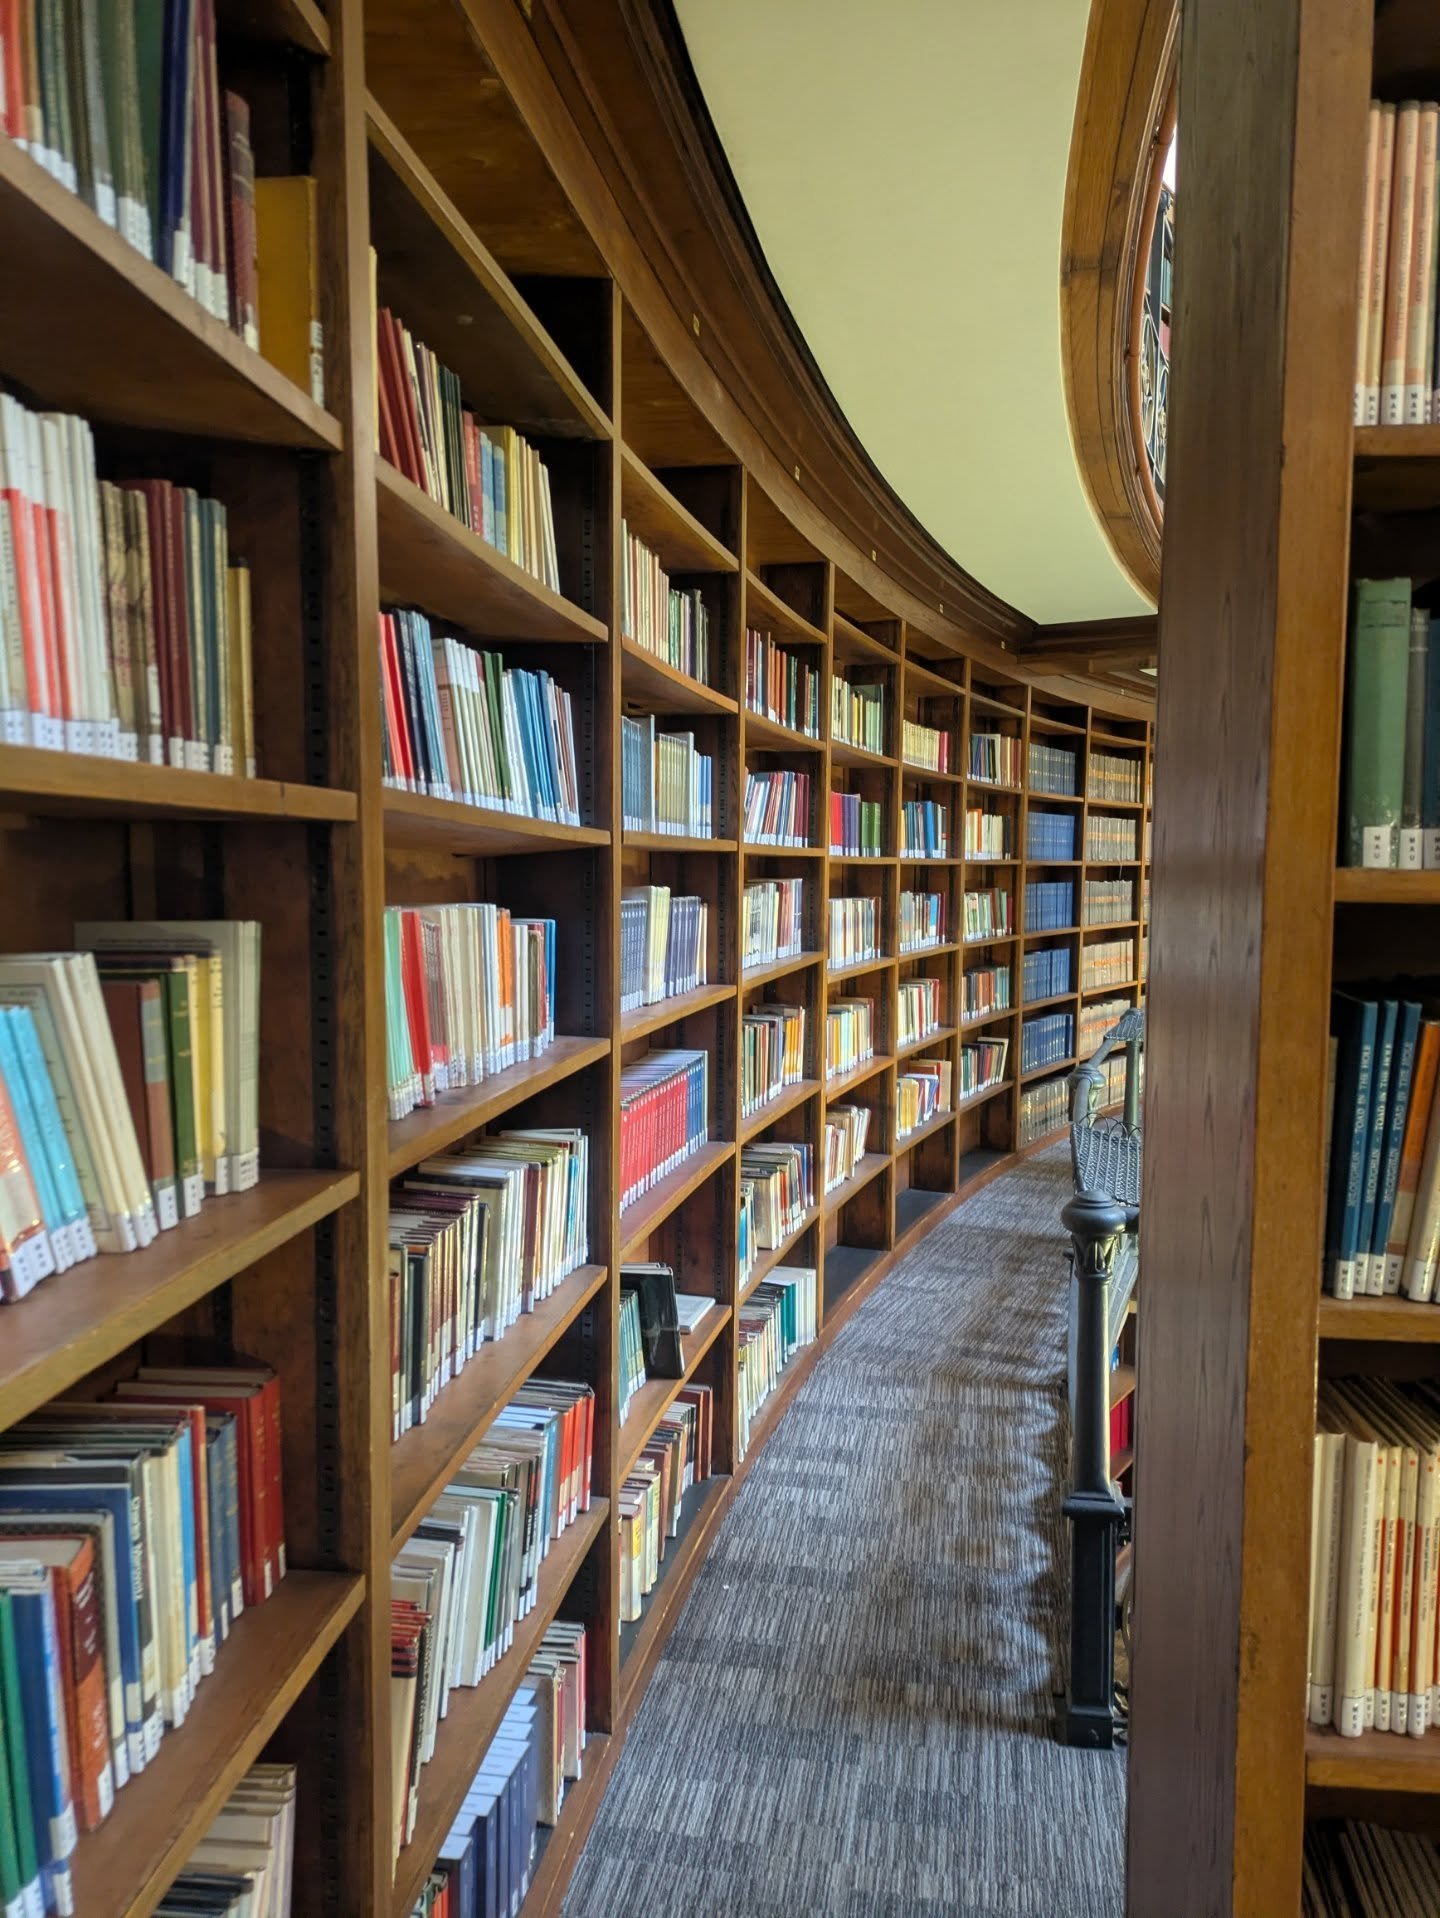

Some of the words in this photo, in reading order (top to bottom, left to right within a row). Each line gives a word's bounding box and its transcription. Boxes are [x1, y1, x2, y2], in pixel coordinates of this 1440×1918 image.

[1361, 1045, 1371, 1069] HOLE
[1383, 1044, 1392, 1067] HOLE
[1402, 1041, 1413, 1066] HOLE
[1359, 1072, 1369, 1090] THE
[1380, 1071, 1389, 1089] THE
[1399, 1068, 1410, 1089] THE
[1354, 1107, 1365, 1133] TOAD
[1375, 1105, 1385, 1131] TOAD
[1393, 1104, 1404, 1131] TOAD
